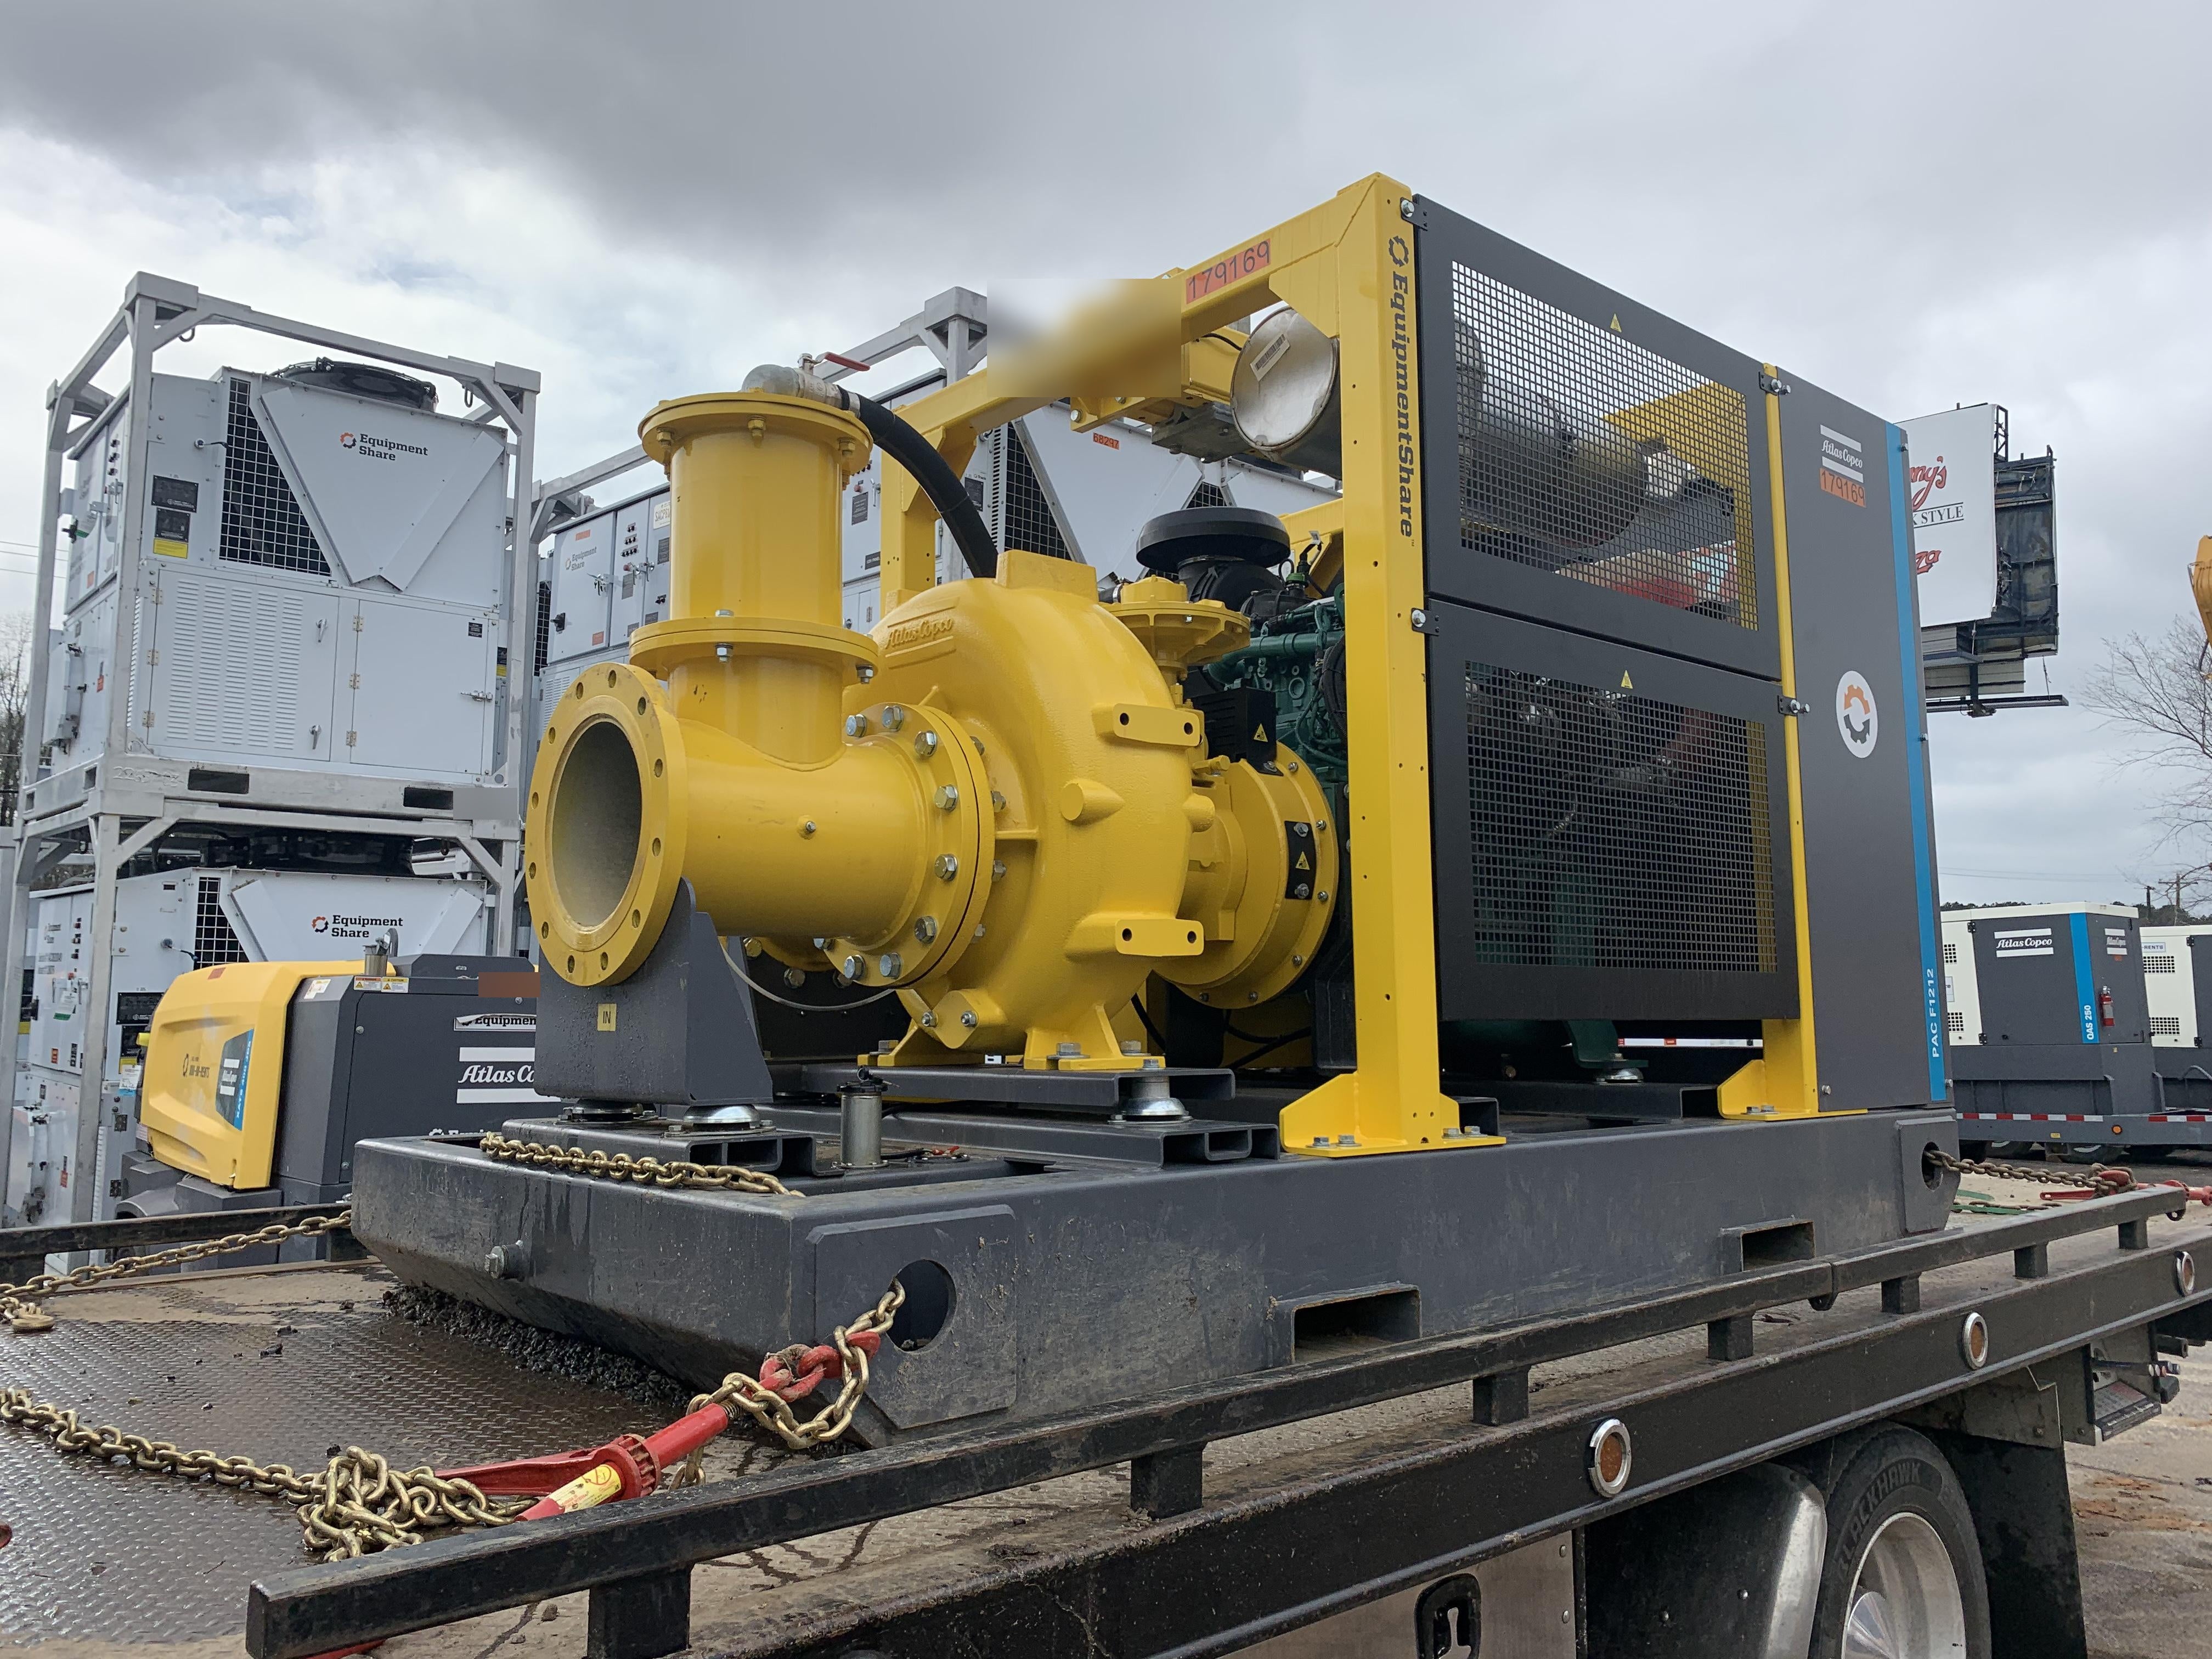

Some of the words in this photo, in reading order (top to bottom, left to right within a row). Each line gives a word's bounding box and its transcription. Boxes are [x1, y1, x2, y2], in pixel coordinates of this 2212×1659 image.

[1189, 240, 1269, 298] 179169
[1390, 270, 1413, 538] EquipmentShare
[359, 433, 428, 456] Equipment
[1093, 433, 1119, 449] 68297
[359, 445, 396, 461] Share
[1821, 440, 1842, 460] Atlas
[1842, 449, 1863, 469] Copco
[1821, 471, 1865, 505] 179169
[1921, 505, 1964, 524] STYLE
[572, 546, 597, 561] Equipment
[571, 561, 585, 571] Share
[885, 629, 919, 650] Atlas
[332, 915, 403, 927] Equipment
[331, 928, 369, 938] Share
[1996, 939, 2024, 948] Atlas
[2024, 938, 2052, 947] Copco
[1927, 968, 1937, 1017] F1212
[475, 1015, 537, 1026] Equipmen
[603, 1011, 611, 1024] IN
[2084, 1005, 2092, 1020] 250
[1930, 1022, 1940, 1058] PAC
[458, 1065, 515, 1084] Atlas
[517, 1065, 535, 1083] Co
